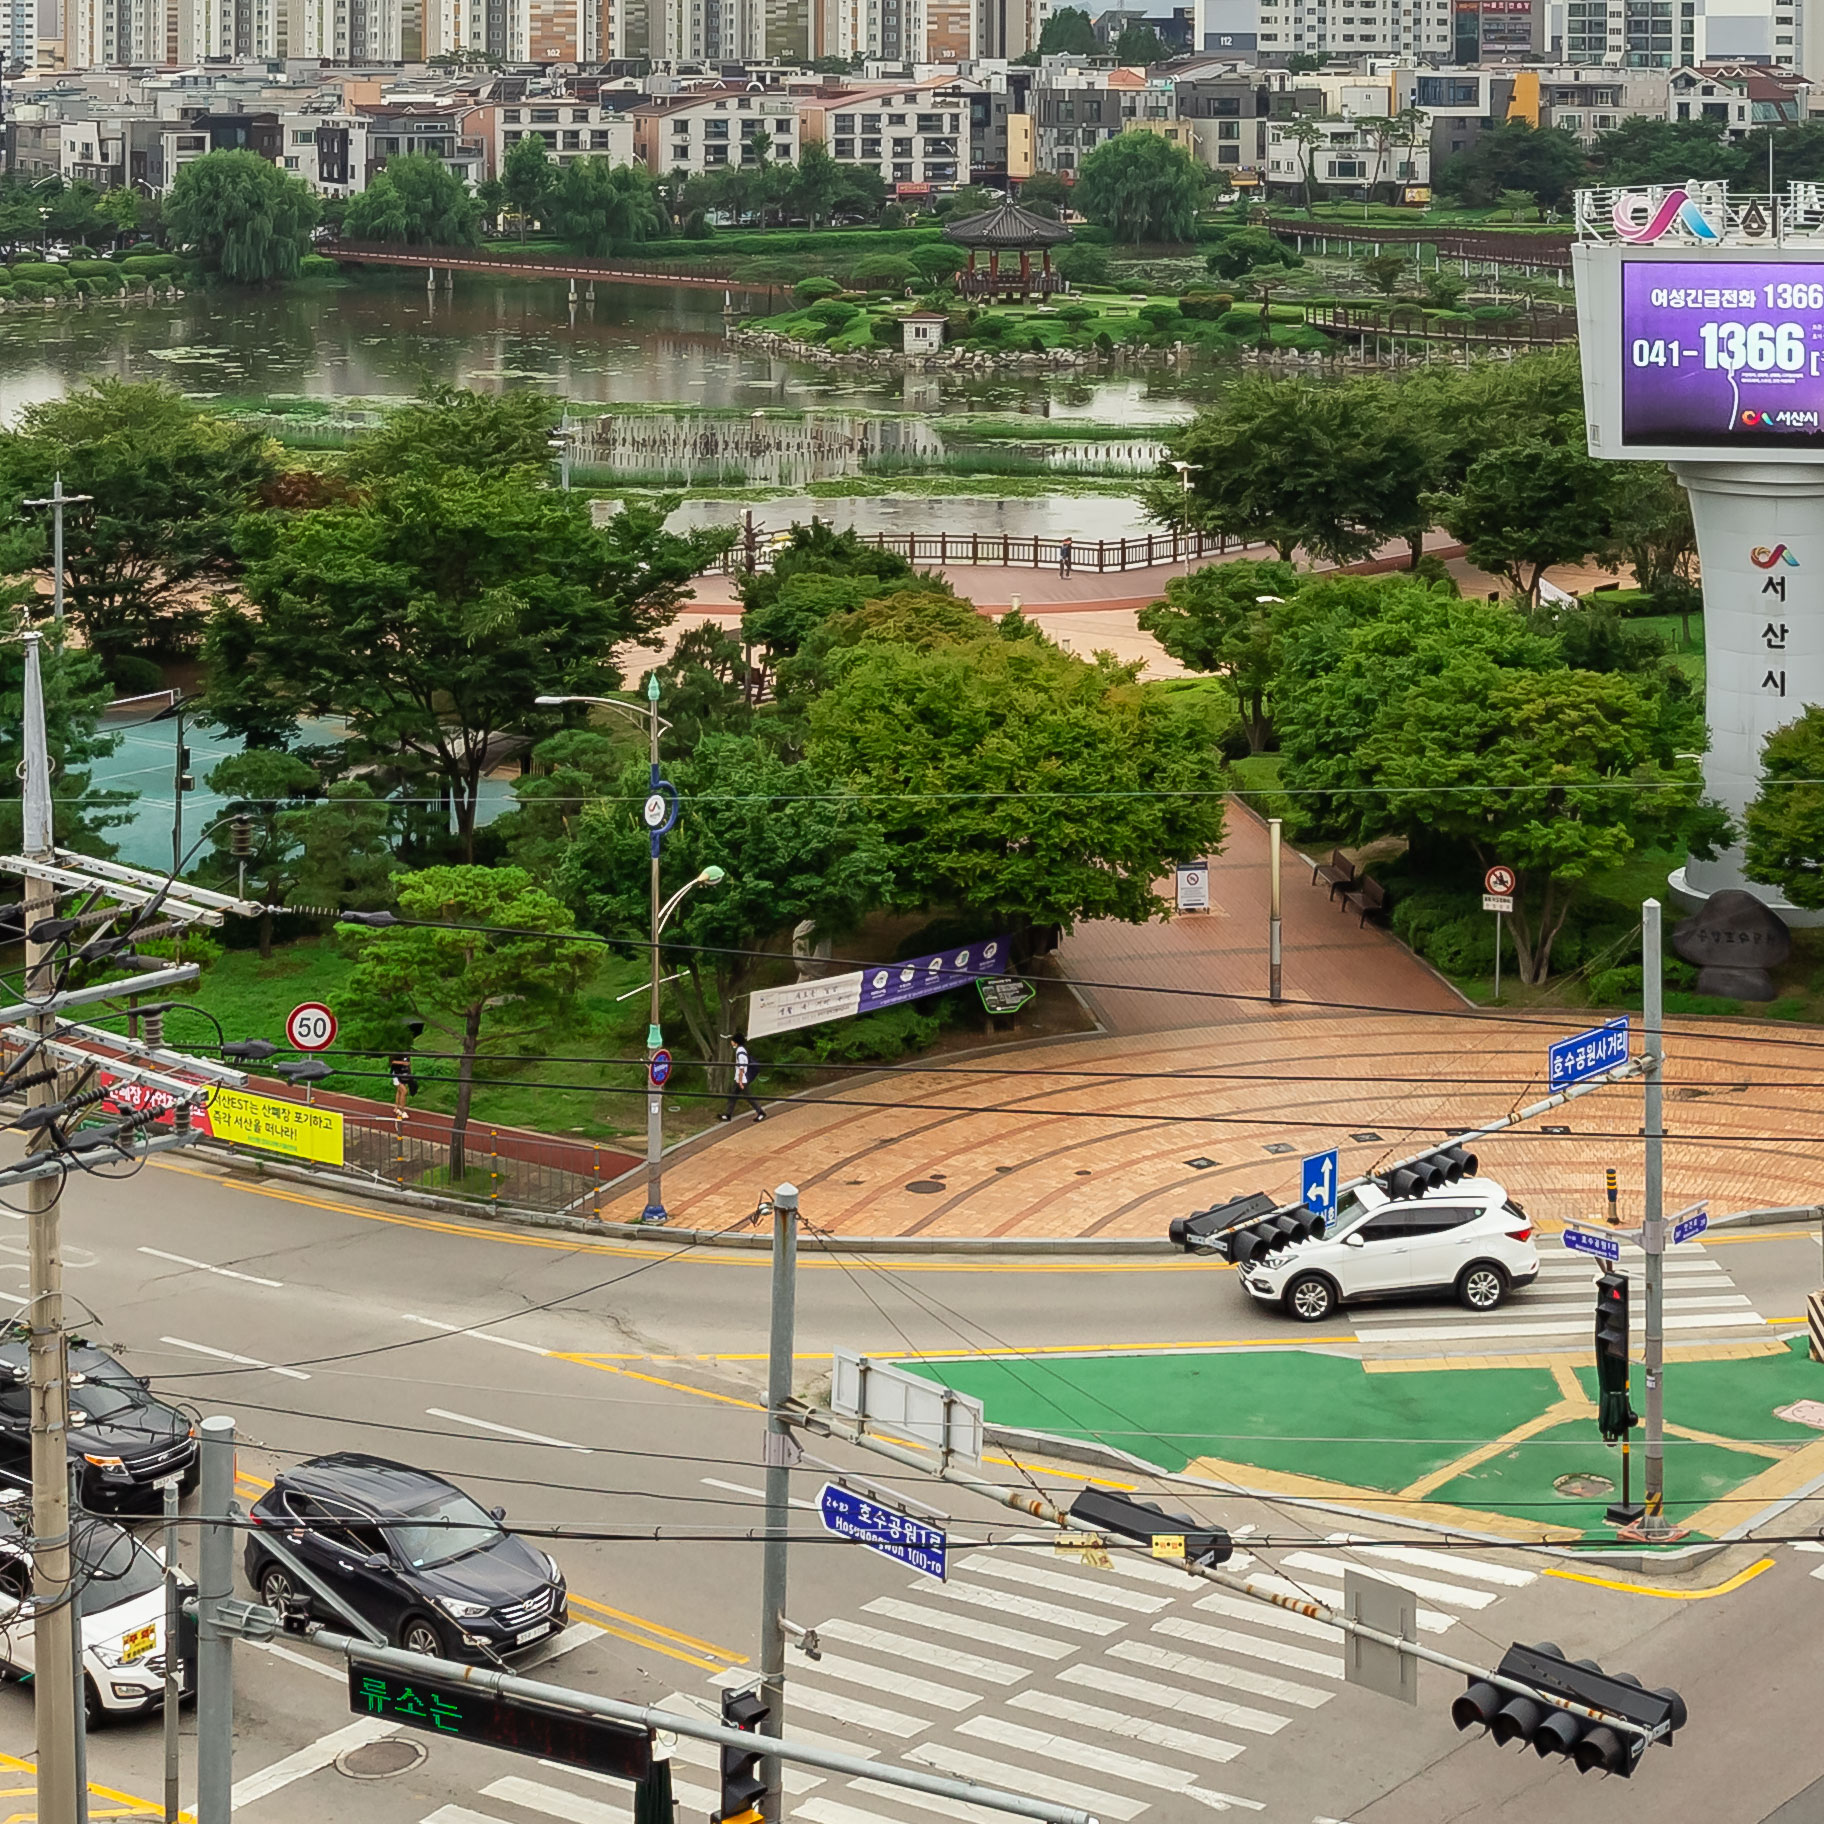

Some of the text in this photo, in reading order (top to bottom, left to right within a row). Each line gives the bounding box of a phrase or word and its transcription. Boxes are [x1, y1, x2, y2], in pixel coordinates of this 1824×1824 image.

[1220, 36, 1233, 46] 112
[546, 49, 561, 57] 102
[942, 50, 955, 58] 103
[1650, 288, 1756, 308] 여성긴급전화
[1764, 283, 1824, 309] 1366
[1776, 411, 1818, 426] 서산시
[297, 1017, 327, 1039] 50
[1552, 1031, 1626, 1079] 호수공원사거리
[233, 1115, 262, 1134] 서산을
[265, 1122, 297, 1140] 떠나라!
[261, 1103, 292, 1121] 산폐장
[294, 1110, 333, 1131] 포기하고
[858, 1503, 943, 1555] 호수공원1로
